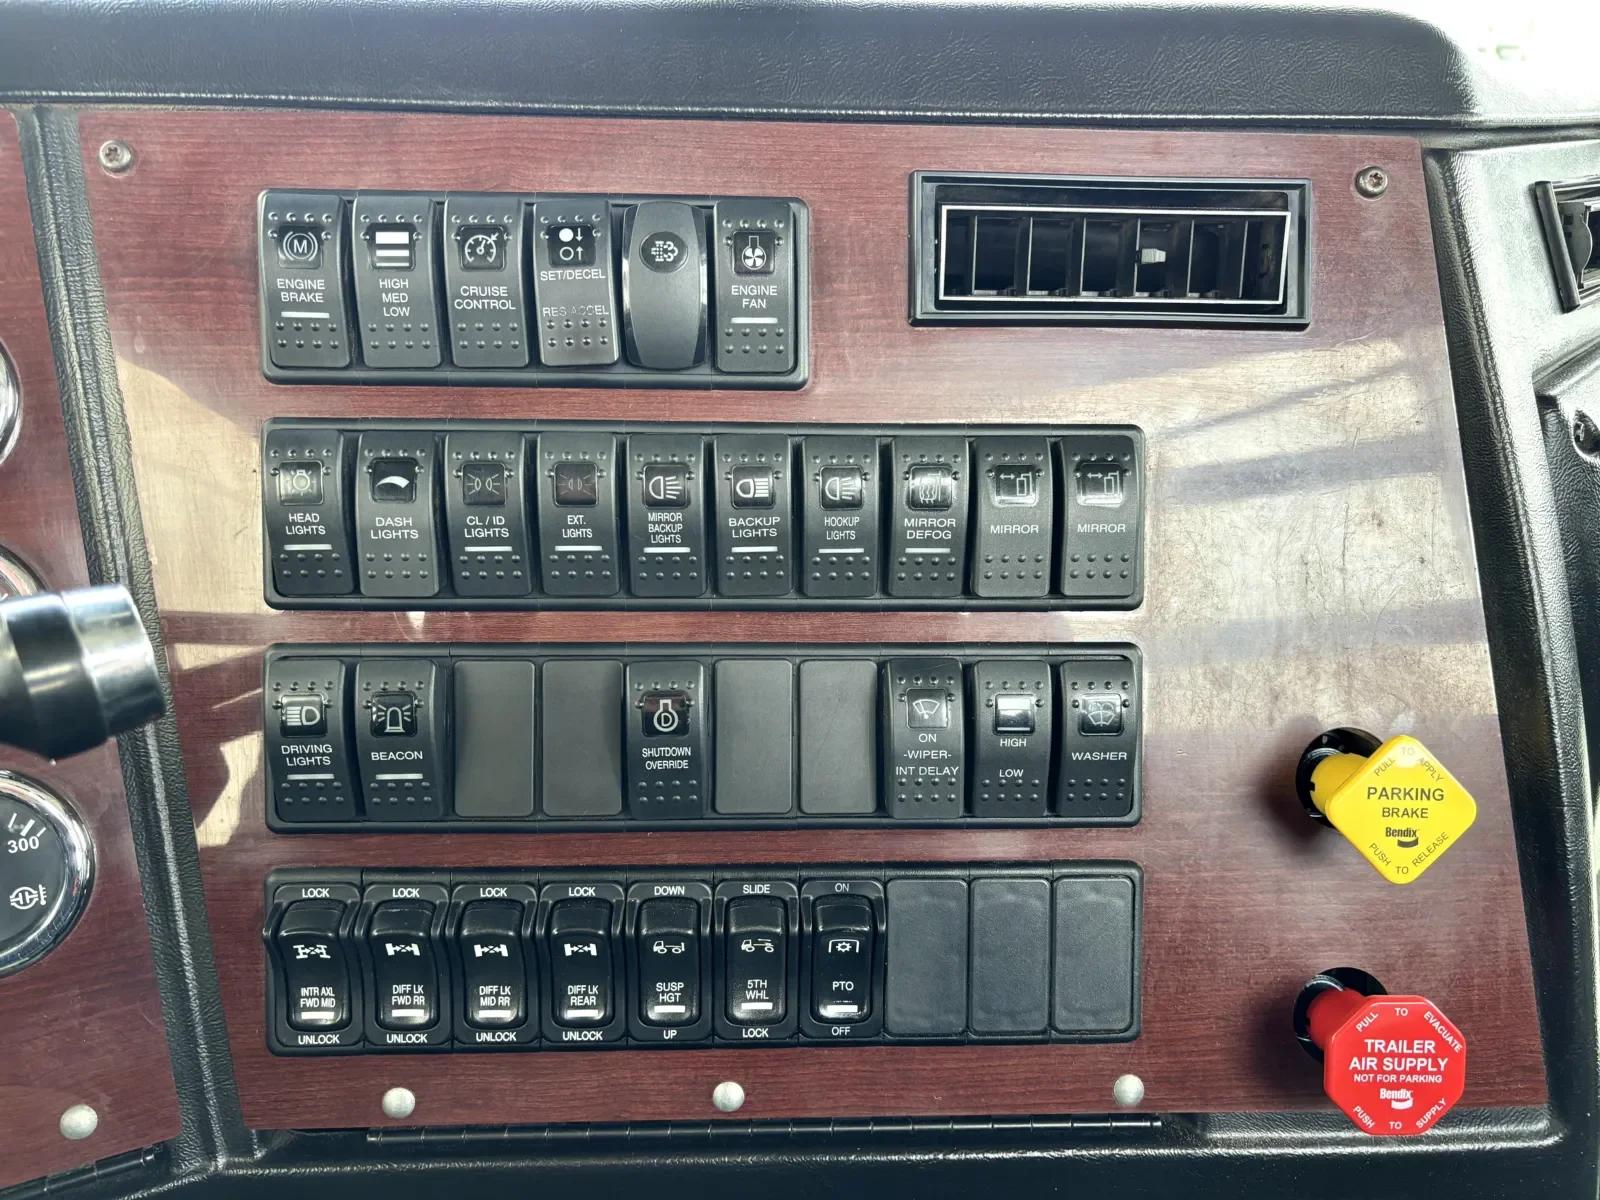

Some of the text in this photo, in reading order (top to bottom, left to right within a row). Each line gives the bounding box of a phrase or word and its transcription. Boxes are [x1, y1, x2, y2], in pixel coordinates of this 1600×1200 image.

[540, 268, 606, 281] SET/DECEL
[277, 279, 325, 290] ENGINE
[379, 278, 409, 289] HIGH
[460, 286, 508, 297] CRUISE
[731, 285, 778, 296] ENGINE
[281, 292, 324, 303] BRAKE
[382, 292, 409, 303] MED
[454, 299, 516, 310] CONTROL
[742, 298, 767, 309] FAN
[383, 306, 410, 317] LOW
[288, 513, 320, 523] HEAD
[375, 517, 413, 527] DASH
[466, 516, 483, 526] CL
[493, 516, 505, 526] ID
[567, 515, 586, 525] EXT.
[648, 512, 683, 522] MIRROR
[728, 516, 781, 528] BACKUP
[824, 516, 860, 527] HOOKUP
[648, 523, 683, 534] BACKUP
[904, 518, 956, 528] MIRROR
[1077, 523, 1126, 534] MIRROR
[285, 525, 326, 536] LIGHTS
[370, 529, 419, 540] LIGHTS
[464, 528, 510, 539] LIGHTS
[562, 528, 593, 539] LIGHTS
[731, 528, 778, 539] LIGHTS
[906, 530, 952, 540] DEFOG
[990, 524, 1039, 535] MIRROR
[651, 534, 682, 544] LIGHTS
[826, 530, 856, 541] LIGHTS
[918, 733, 937, 743] ON
[999, 738, 1027, 748] HIGH
[281, 744, 333, 755] DRIVING
[641, 746, 692, 758] SHUTDOWN
[371, 750, 424, 761] BEACON
[1071, 751, 1128, 761] WASHER
[286, 756, 331, 767] LIGHTS
[645, 760, 689, 770] OVERRIDE
[895, 766, 960, 776] INT DELAY
[999, 768, 1024, 778] LOW
[1374, 757, 1396, 777] PULL
[1417, 757, 1445, 782] APPLY
[1367, 786, 1445, 802] PARKING
[1382, 807, 1429, 819] BRAKE
[1385, 826, 1418, 838] Bendix
[7, 835, 40, 854] 300
[1369, 831, 1449, 875] PUSH TO RELEASE
[301, 887, 330, 898] LOCK
[392, 887, 420, 898] LOCK
[479, 887, 508, 898] LOCK
[568, 886, 596, 898] LOCK
[653, 885, 686, 896] DOWN
[742, 884, 771, 895] SLIDE
[834, 883, 850, 893] ON
[392, 984, 424, 995] DIFF LK
[567, 984, 599, 995] DIFF LK
[655, 982, 685, 993] SUSP
[746, 979, 768, 990] 5TH
[832, 981, 854, 991] PTO
[300, 986, 336, 997] INTR AXL
[479, 985, 511, 996] DIFF LK
[745, 990, 770, 1001] WHL
[300, 997, 336, 1008] FWD MID
[391, 995, 425, 1006] FWD RR
[480, 996, 510, 1007] MID RR
[570, 995, 597, 1006] REAR
[658, 992, 682, 1003] HGT
[562, 1030, 603, 1041] UNLOCK
[662, 1029, 677, 1040] UP
[742, 1027, 769, 1038] LOCK
[831, 1026, 851, 1036] OFF
[1355, 1007, 1463, 1054] PULL TO EVACUATE
[298, 1034, 340, 1045] UNLOCK
[386, 1033, 428, 1044] UNLOCK
[475, 1031, 517, 1043] UNLOCK
[1364, 1039, 1436, 1054] TRAILER
[1349, 1057, 1449, 1072] AIR SUPPLY
[1353, 1073, 1443, 1084] NOT FOR PARKING
[1379, 1088, 1412, 1100] Bendix
[1352, 1097, 1447, 1130] PUSH TO SUPPLY
